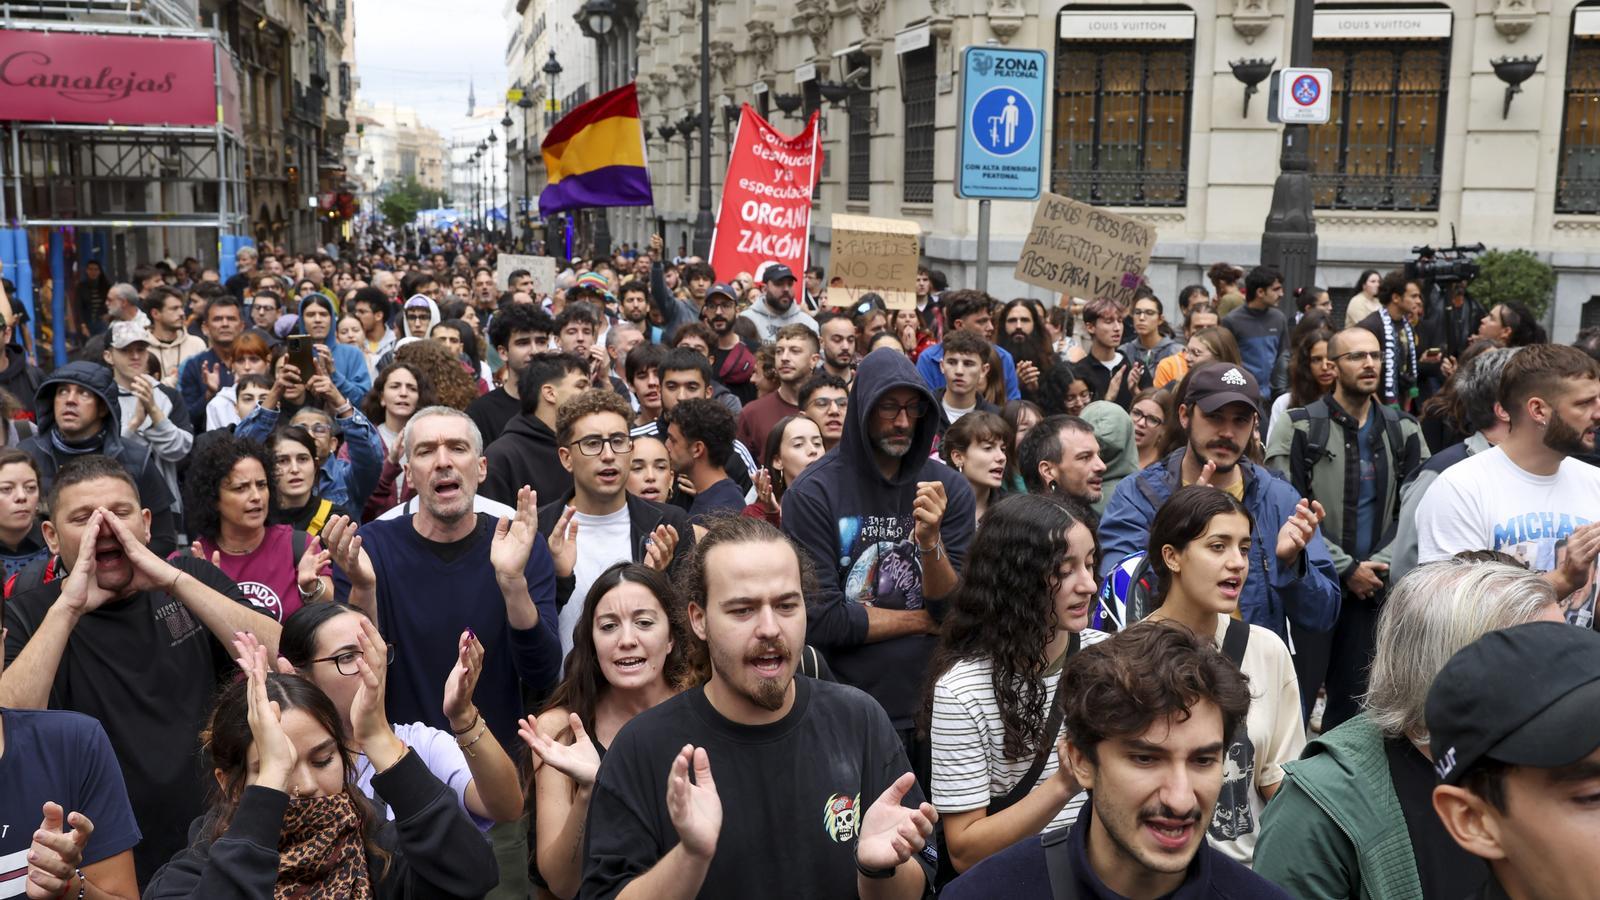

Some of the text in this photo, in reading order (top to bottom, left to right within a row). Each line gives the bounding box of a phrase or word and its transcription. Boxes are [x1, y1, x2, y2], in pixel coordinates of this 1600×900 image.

[1088, 21, 1167, 31] LOUIS VUITTON
[1339, 20, 1421, 30] LOUIS VUITTON
[995, 57, 1038, 71] ZONA
[0, 50, 176, 104] Canalejas
[994, 69, 1038, 79] PEATONAL
[964, 163, 981, 171] CON
[1001, 165, 1038, 173] DENSIDAD
[982, 172, 1019, 180] PEATONAL
[835, 260, 905, 280] NO SE
[1058, 261, 1091, 289] PARA
[1494, 511, 1592, 551] MICHA
[239, 584, 277, 607] ENDO
